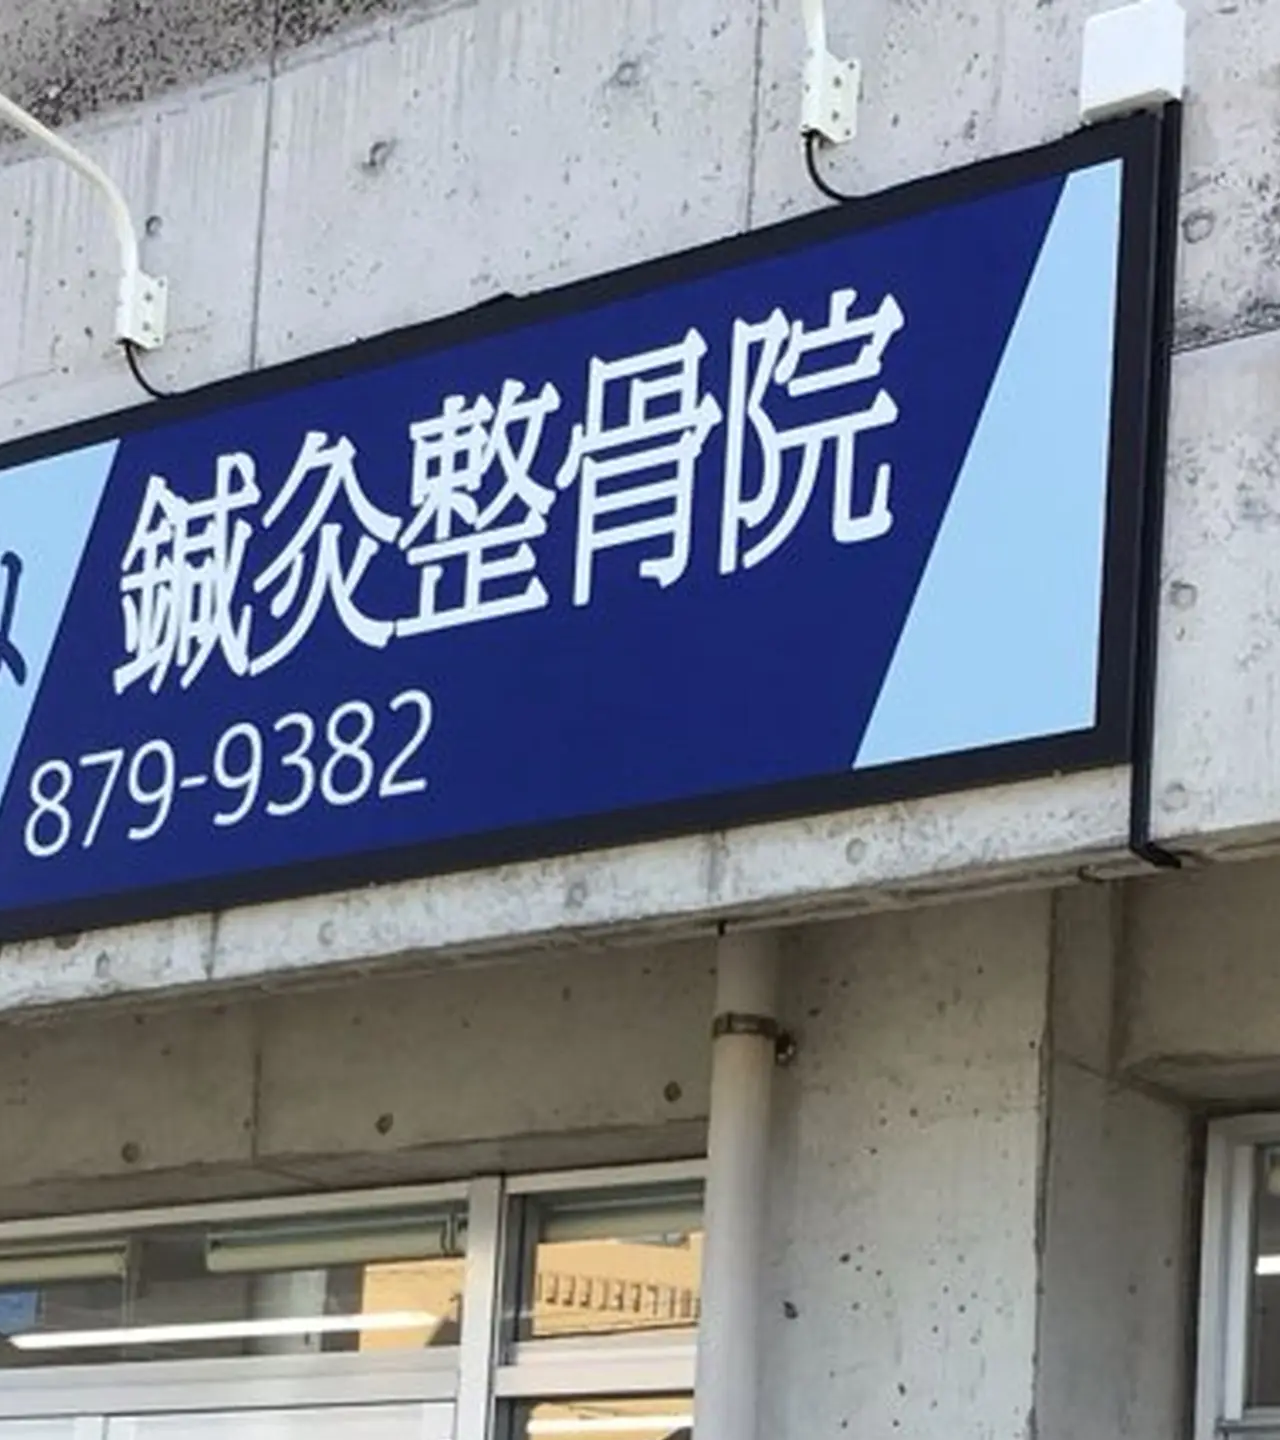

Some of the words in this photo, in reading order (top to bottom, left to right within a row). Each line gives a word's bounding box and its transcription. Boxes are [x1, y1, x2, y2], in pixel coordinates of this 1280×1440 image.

[114, 289, 903, 694] 鍼灸整骨院
[26, 691, 431, 856] 879-9382
